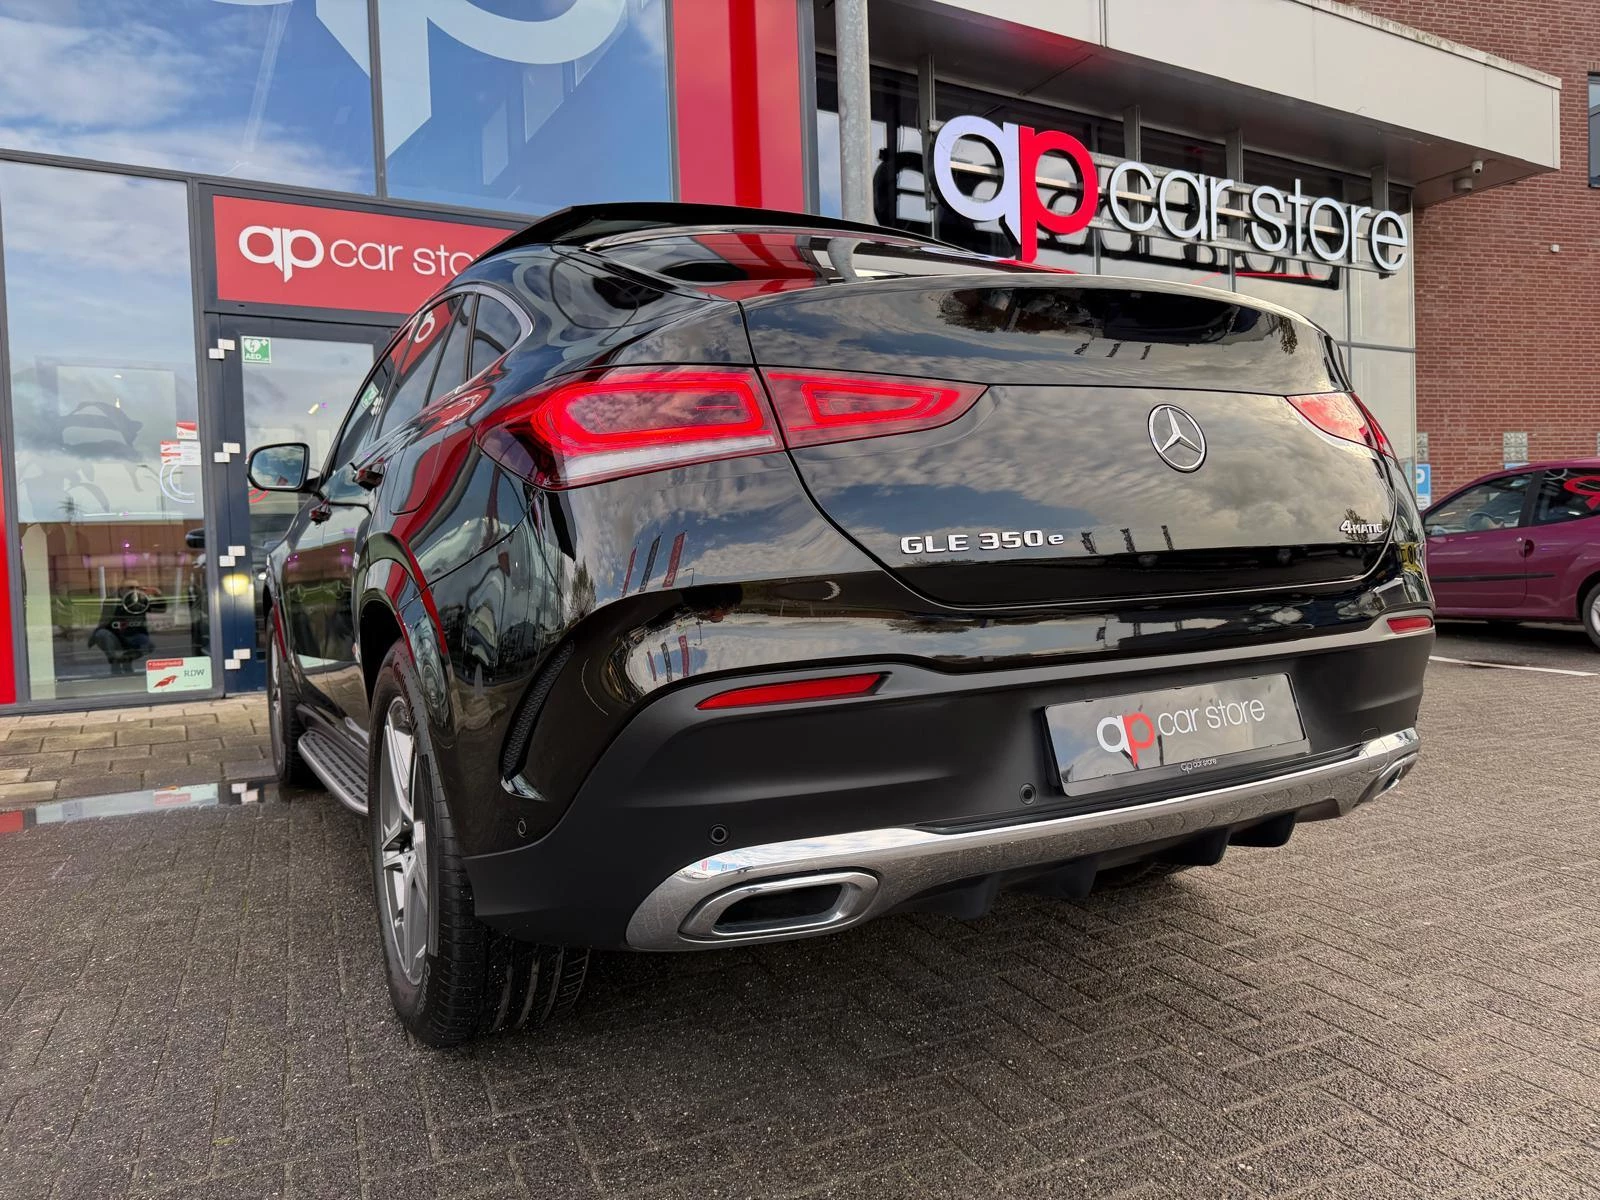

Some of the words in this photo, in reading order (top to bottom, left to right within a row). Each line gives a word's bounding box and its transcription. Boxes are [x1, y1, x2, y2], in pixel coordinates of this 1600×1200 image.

[933, 114, 1098, 263] ap
[1108, 160, 1234, 241] car
[1250, 179, 1409, 271] store
[238, 225, 325, 282] ap
[330, 239, 403, 271] car
[412, 244, 480, 276] sto
[1340, 519, 1383, 533] 4MATIC
[900, 534, 970, 554] GLE
[184, 669, 205, 677] RDW
[1096, 712, 1155, 768] ap
[1157, 707, 1199, 736] car
[1205, 699, 1266, 729] store
[1202, 758, 1217, 767] store
